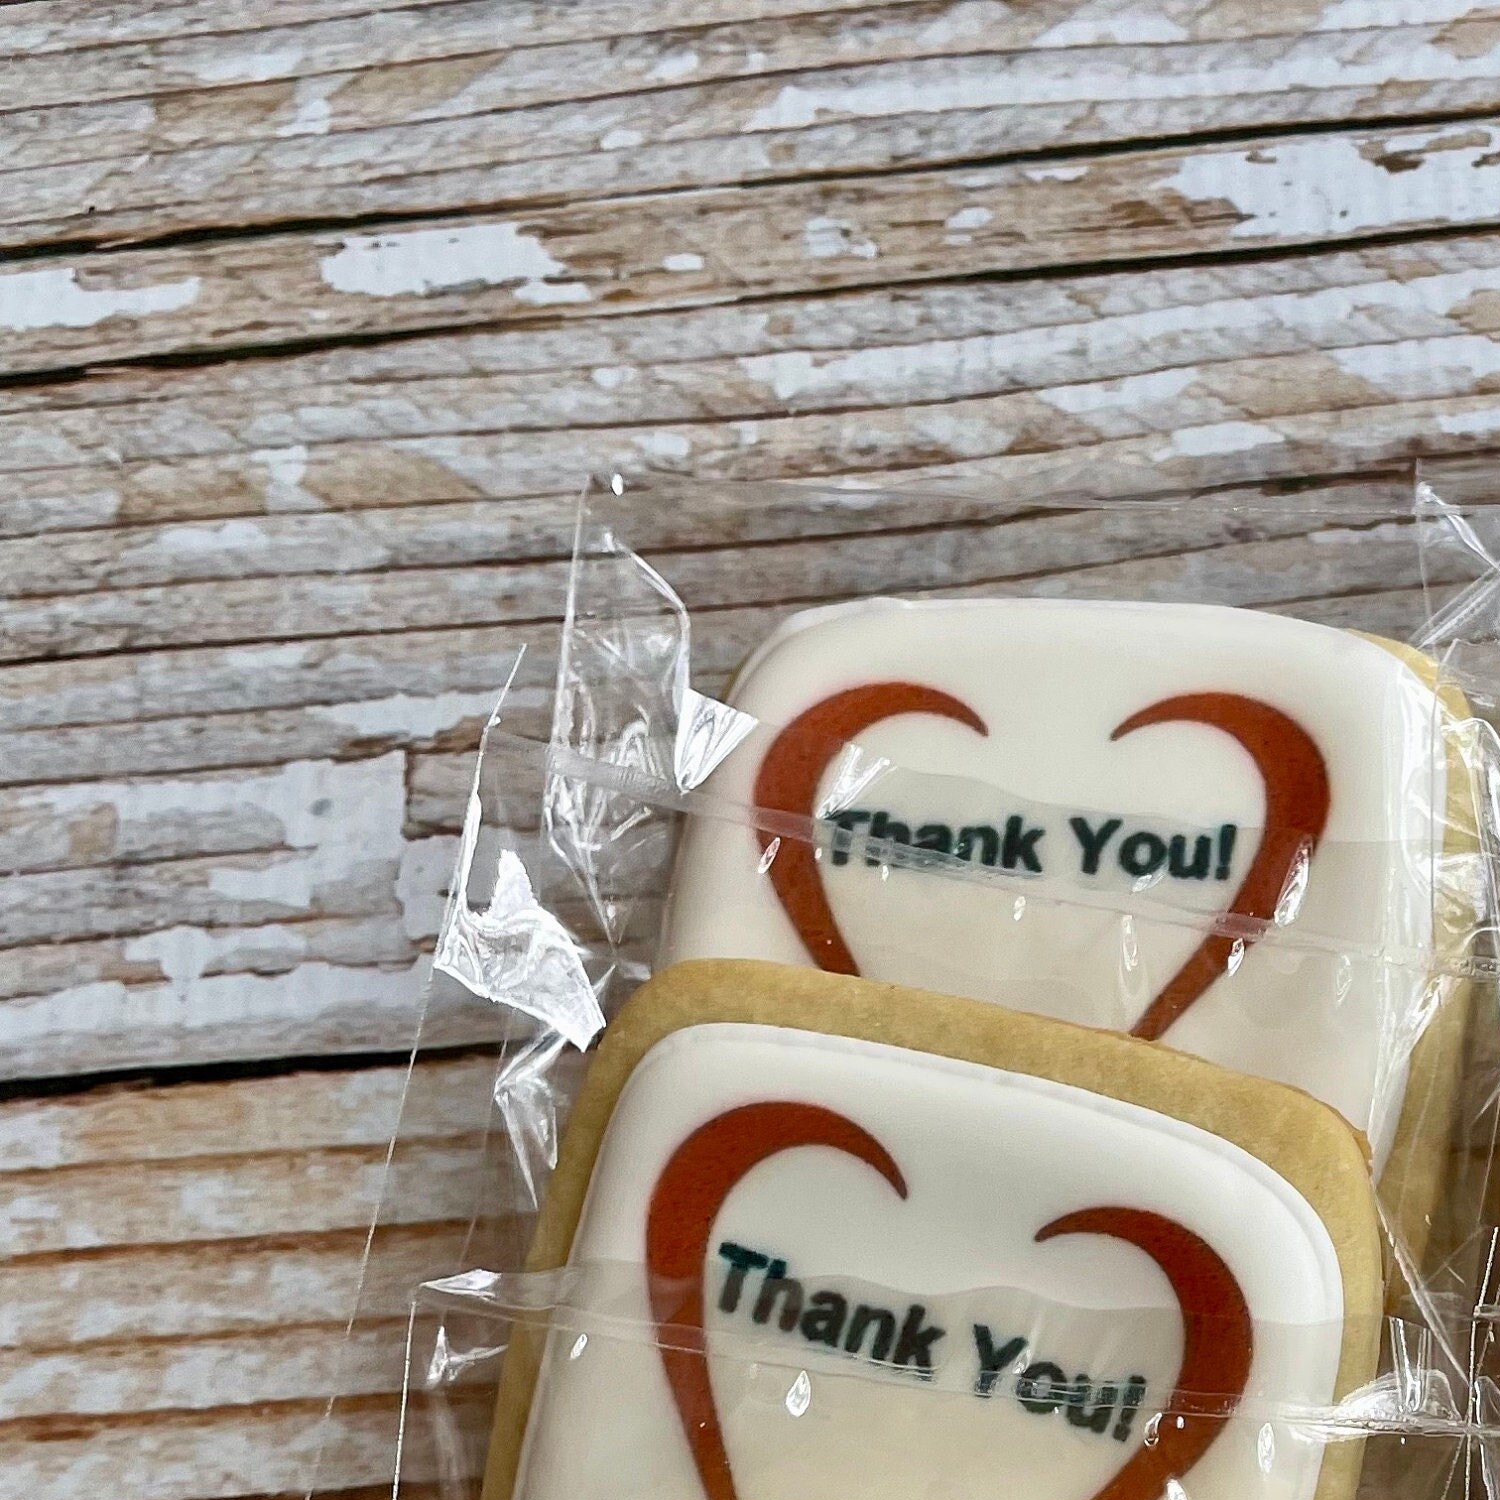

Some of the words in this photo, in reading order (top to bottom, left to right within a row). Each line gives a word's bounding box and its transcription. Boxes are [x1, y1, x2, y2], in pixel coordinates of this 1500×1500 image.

[826, 804, 1044, 875] Thank
[1068, 815, 1239, 882] You!
[716, 1241, 947, 1376] Thank
[972, 1323, 1149, 1445] You!
